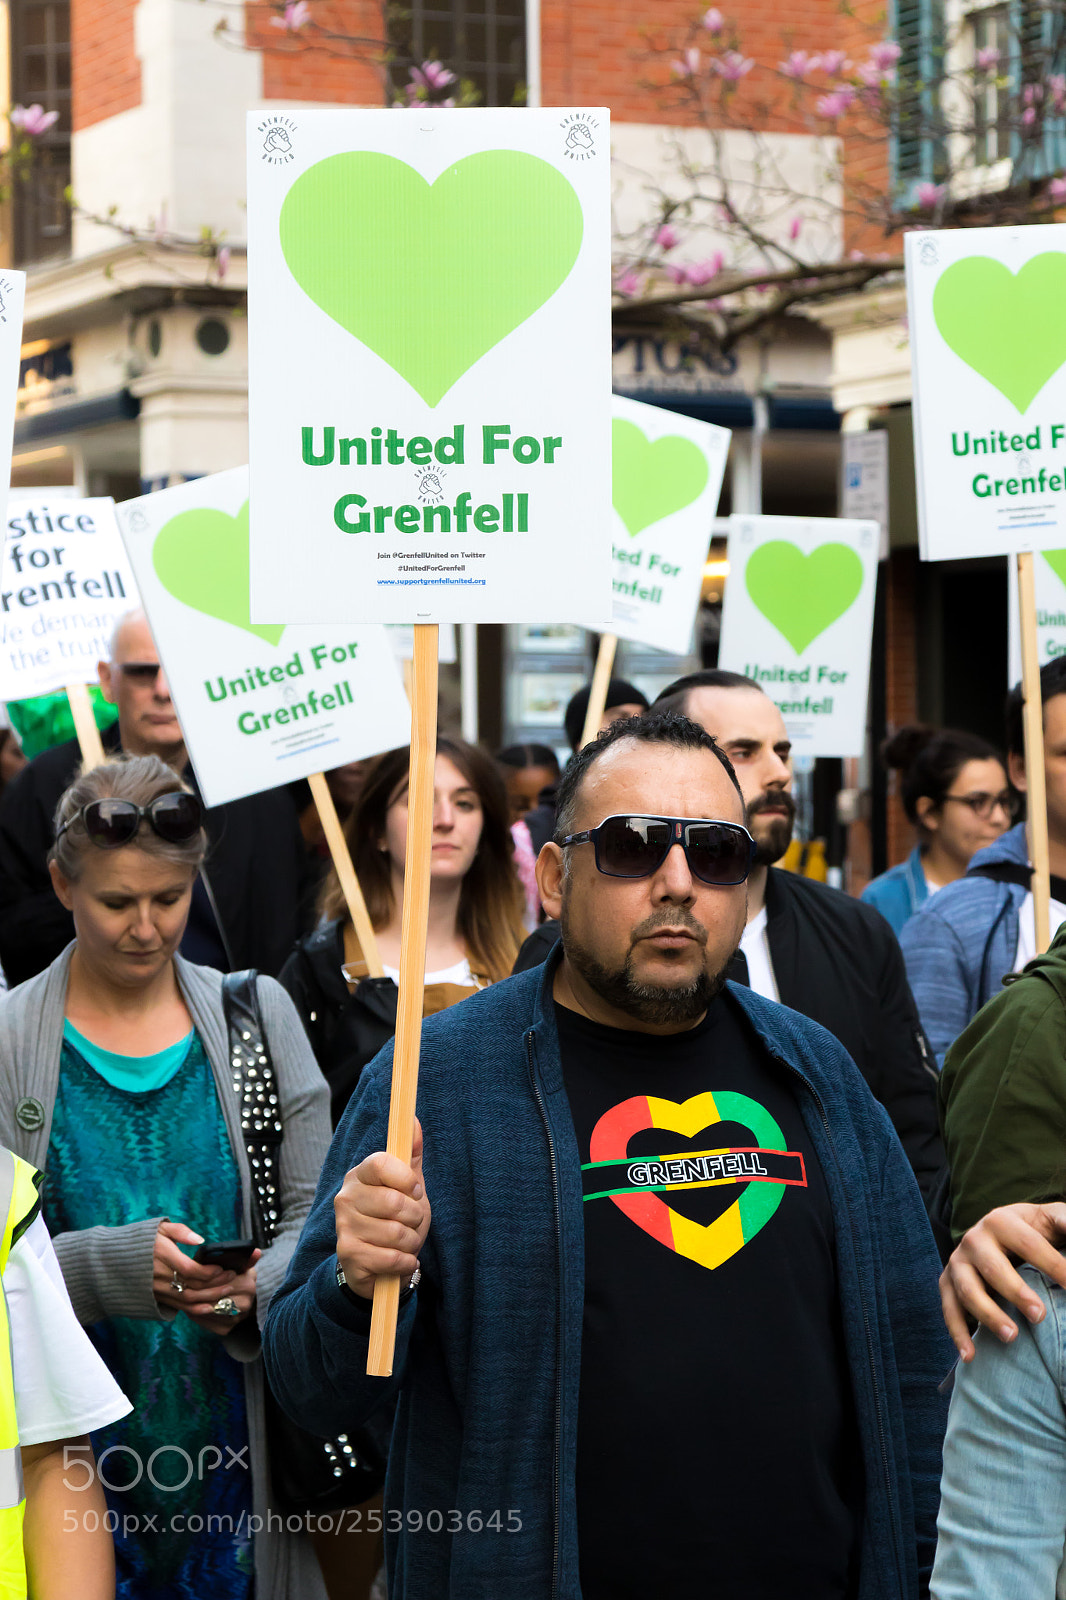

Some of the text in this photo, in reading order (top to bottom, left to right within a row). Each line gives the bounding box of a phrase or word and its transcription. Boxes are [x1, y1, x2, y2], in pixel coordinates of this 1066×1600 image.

[257, 116, 298, 133] GRENFELL
[560, 112, 600, 129] GRENFELL
[262, 153, 296, 166] UNITED
[564, 149, 597, 161] UNITED
[301, 424, 563, 466] United For
[951, 425, 1041, 456] United
[8, 507, 96, 539] stice
[333, 492, 529, 534] Grenfell
[10, 543, 65, 573] for
[377, 552, 391, 560] Join
[392, 552, 448, 560] @GrenfellUnited
[397, 564, 466, 573] #UnitedForGrenfell
[648, 554, 682, 578] For
[1, 570, 126, 611] renfell
[377, 577, 487, 587] www.supportgrenfellunited.org
[31, 612, 116, 638] deman
[9, 647, 50, 672] the
[203, 653, 304, 704] United
[309, 641, 359, 670] For
[744, 664, 848, 683] United For
[236, 681, 354, 735] Grenfell
[626, 1153, 768, 1185] GRENFELL
